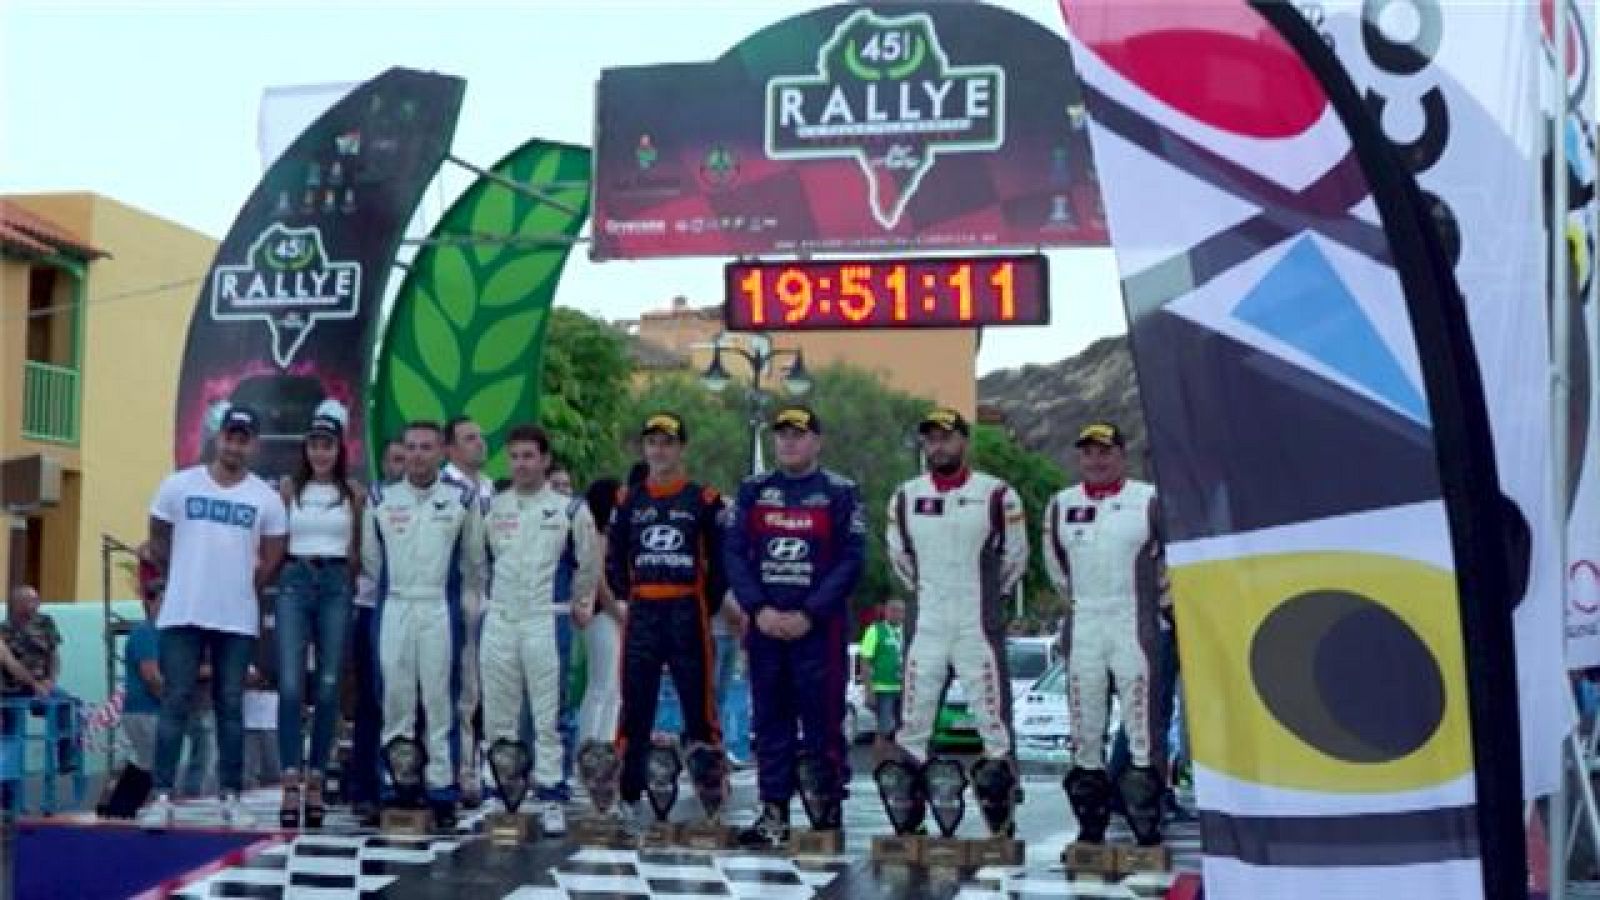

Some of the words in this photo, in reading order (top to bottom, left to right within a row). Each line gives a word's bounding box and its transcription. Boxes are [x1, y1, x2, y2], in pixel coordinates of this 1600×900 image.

[860, 31, 901, 62] 45
[779, 78, 991, 127] RALLYE
[221, 269, 353, 298] RALLYE
[741, 263, 1016, 324] 19:51:11
